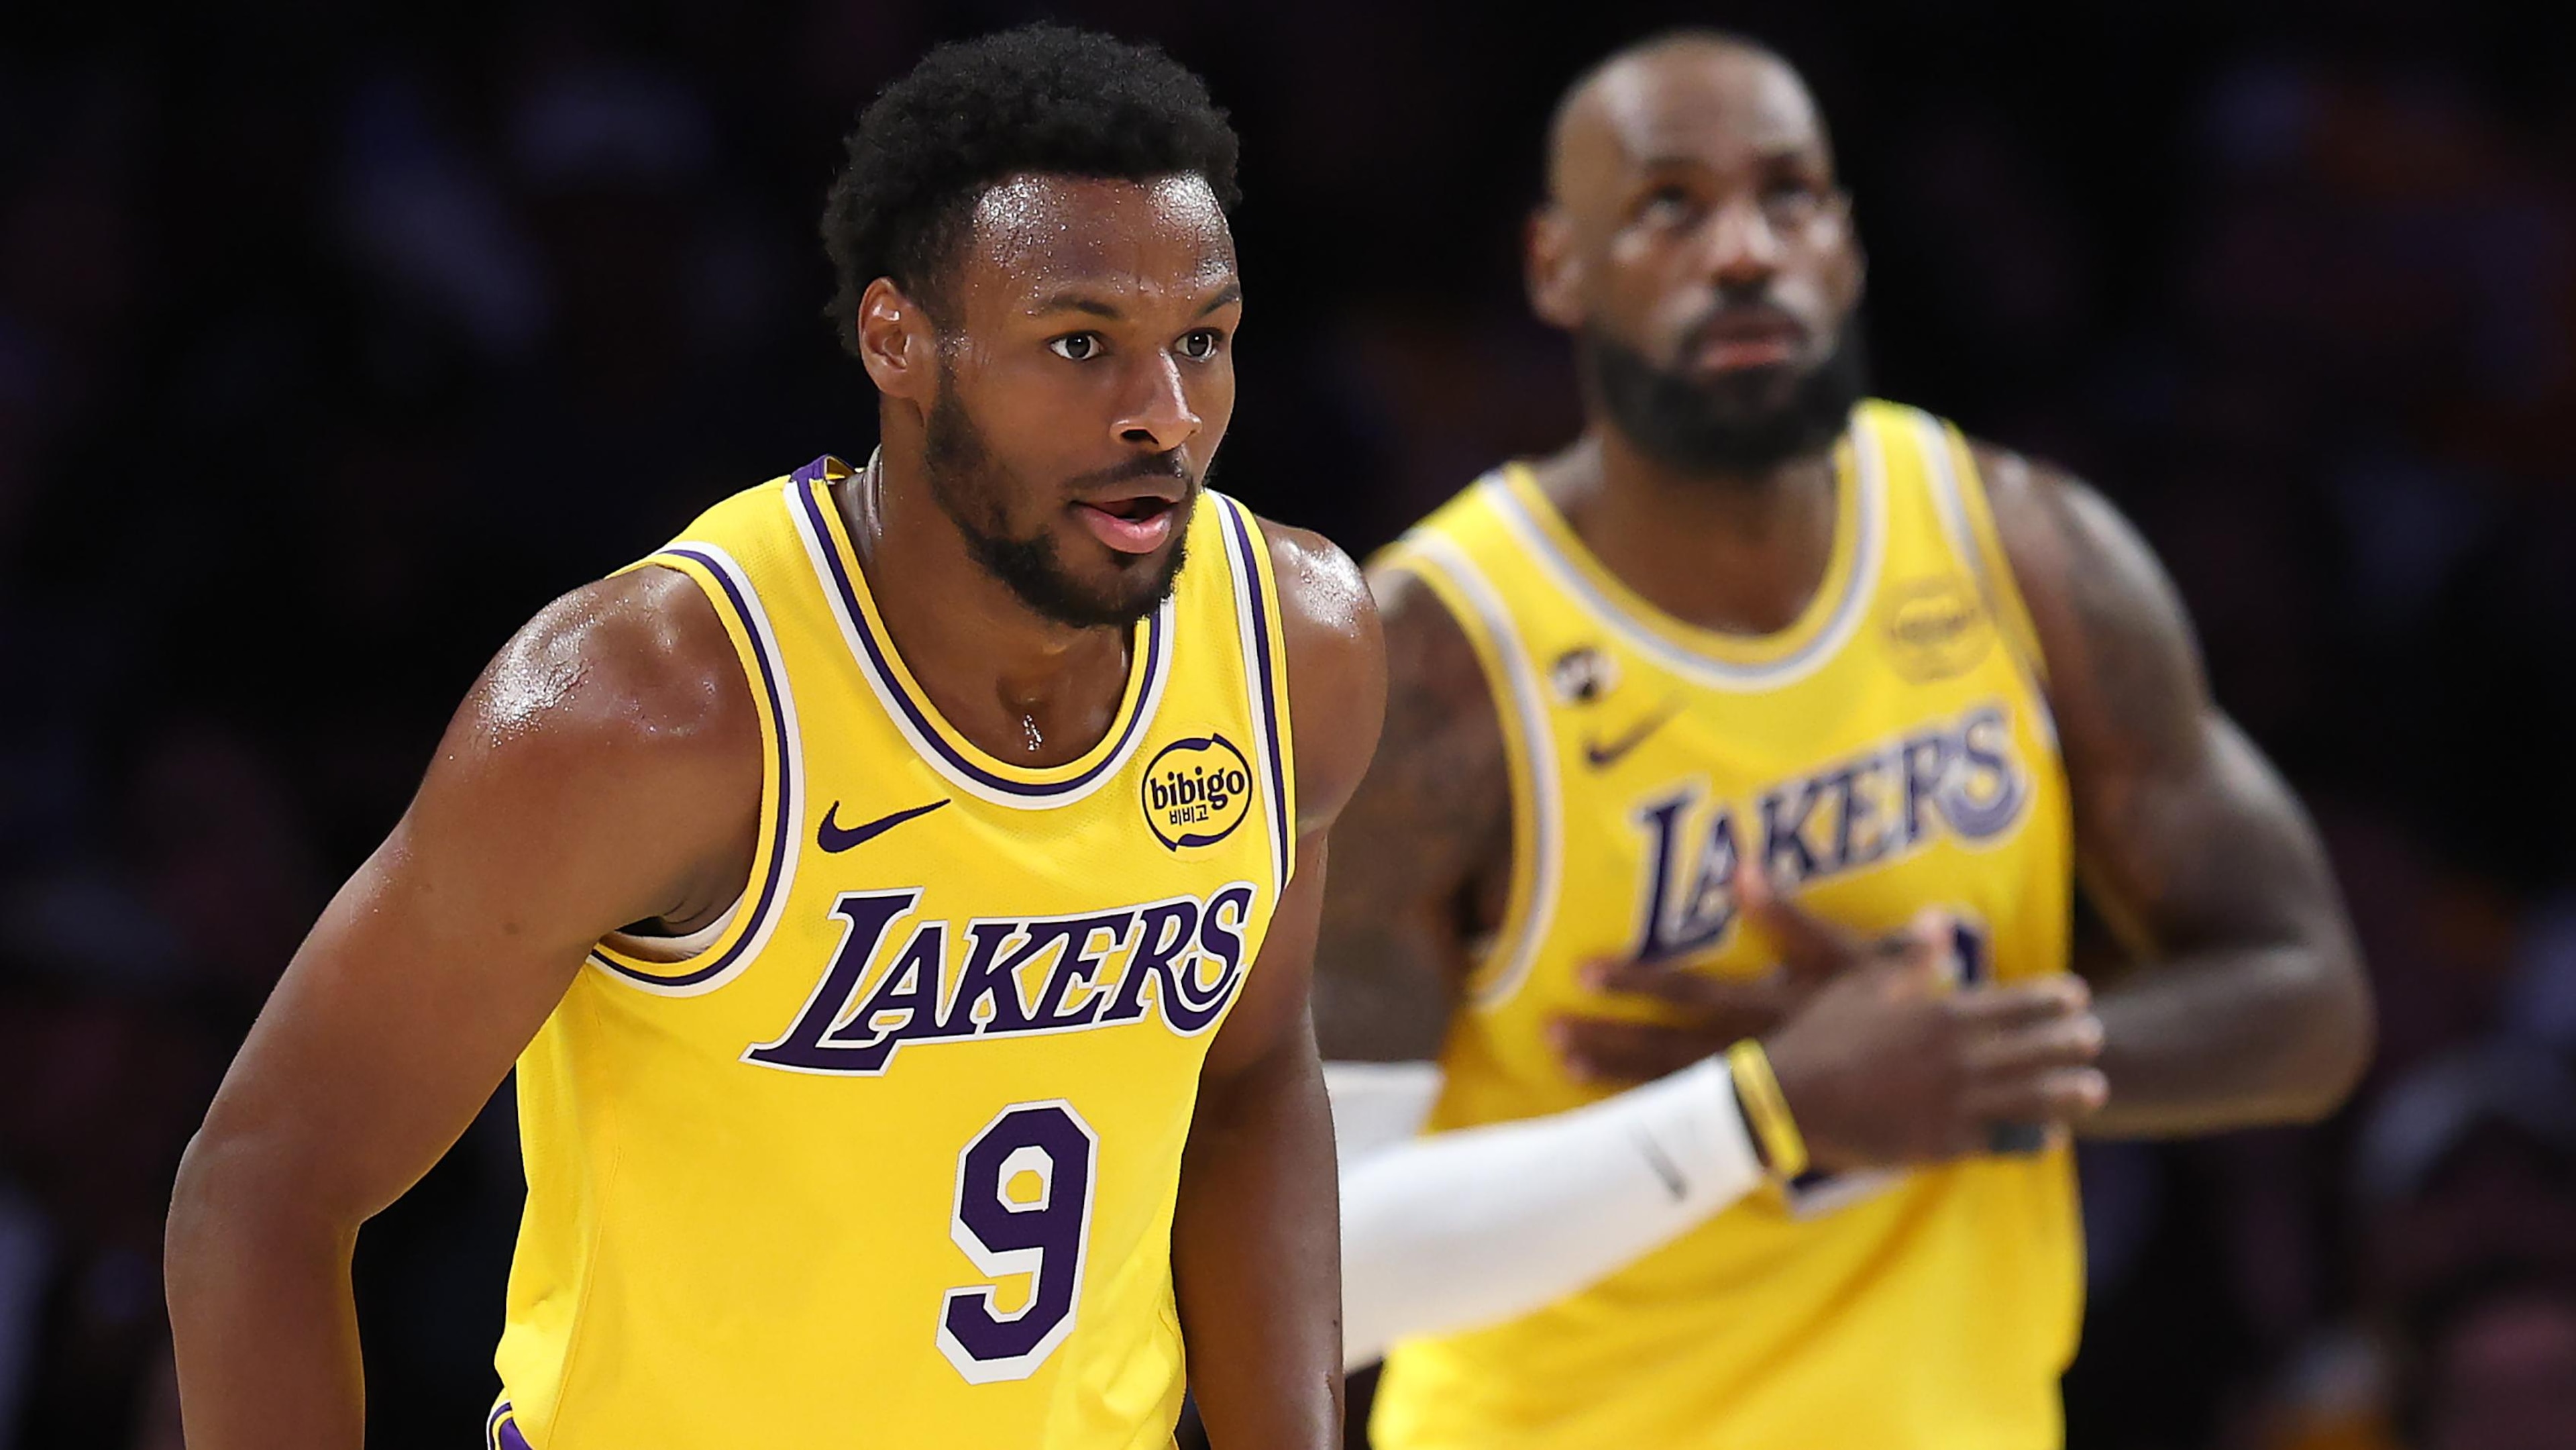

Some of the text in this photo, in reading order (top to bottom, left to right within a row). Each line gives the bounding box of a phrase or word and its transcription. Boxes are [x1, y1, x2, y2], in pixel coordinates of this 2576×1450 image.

[1150, 766, 1245, 810] bibigo
[1169, 805, 1209, 825] 비비고
[1633, 702, 2030, 965] LAKERS
[739, 881, 1258, 1076] LAKERS
[936, 1098, 1099, 1384] 9
